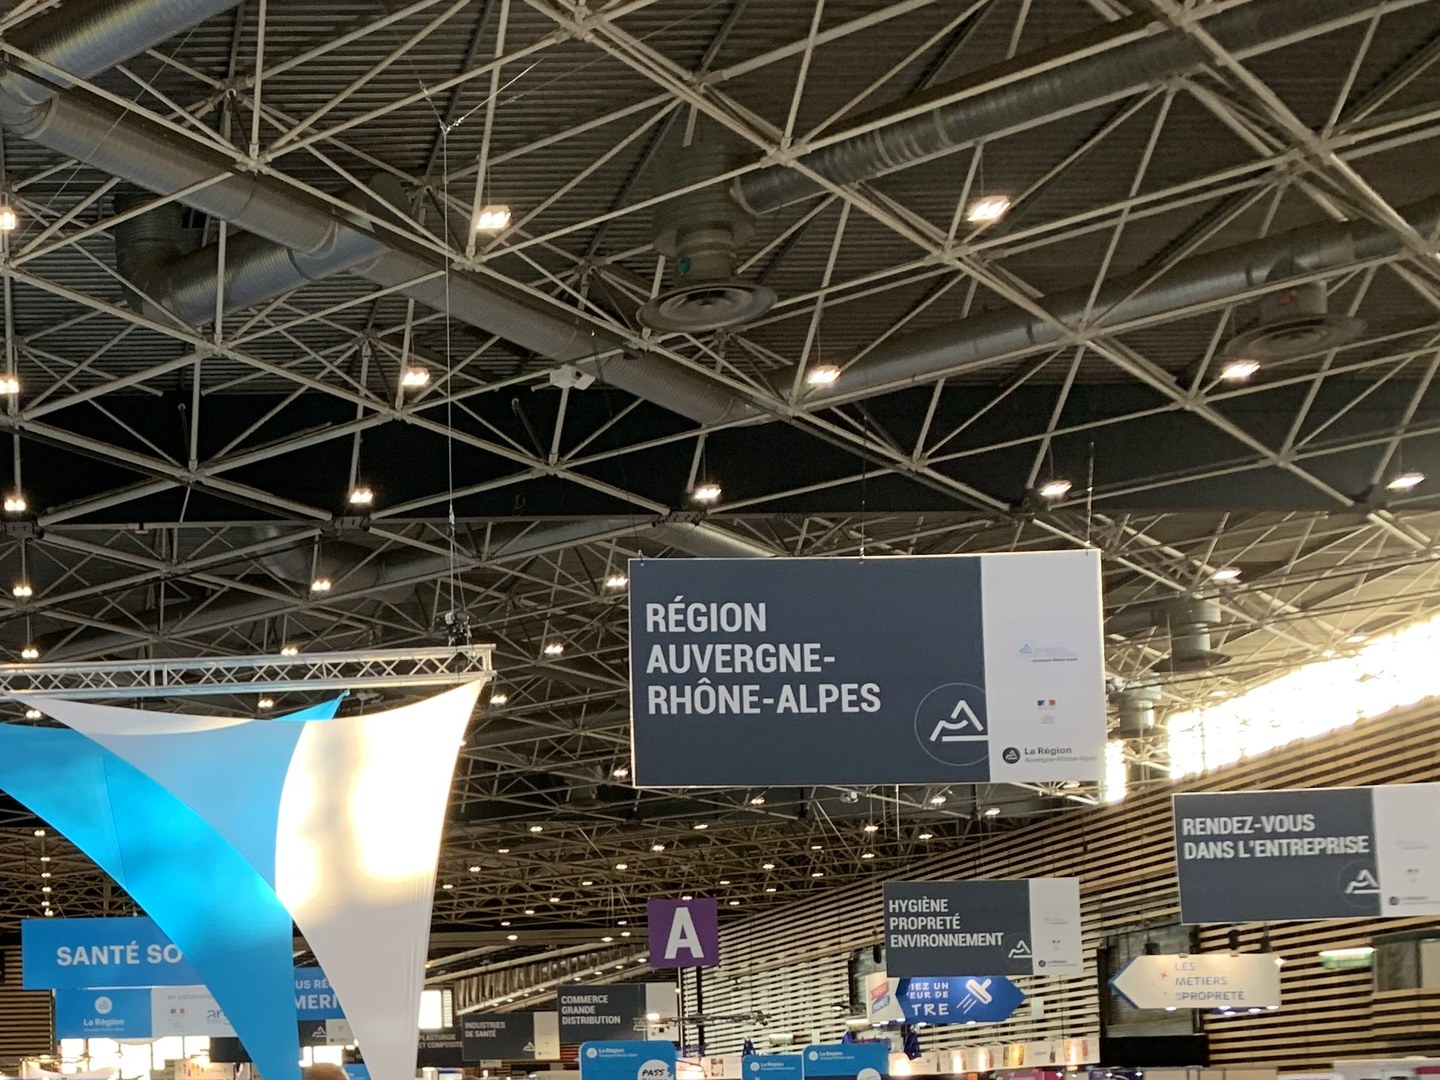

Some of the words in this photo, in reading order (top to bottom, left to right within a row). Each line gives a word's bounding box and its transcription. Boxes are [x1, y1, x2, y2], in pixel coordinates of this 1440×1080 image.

[646, 595, 767, 633] RÉGION
[646, 643, 836, 674] AUVERGNE-
[648, 677, 882, 715] RHÔNE-ALPES
[1024, 747, 1036, 755] La
[1038, 746, 1072, 756] Région
[1182, 814, 1316, 836] RENDEZ-VOUS
[1184, 841, 1235, 860] DANS
[1238, 835, 1370, 858] L'ENTREPRISE
[889, 896, 949, 913] HYGIÈNE
[890, 913, 961, 930] PROPRETÉ
[664, 907, 704, 959] A
[890, 932, 1004, 948] ENVIRONNEMENT
[56, 940, 140, 966] SANTÉ
[1175, 962, 1196, 971] LES
[934, 982, 949, 990] UN
[561, 995, 608, 1004] COMMERCE
[906, 991, 931, 999] EUR
[935, 991, 949, 999] DE
[561, 1006, 595, 1014] GRANDE
[83, 1018, 93, 1026] La
[95, 1018, 125, 1027] Région
[562, 1015, 621, 1025] DISTRIBUTION
[475, 1029, 496, 1037] SANTÉ
